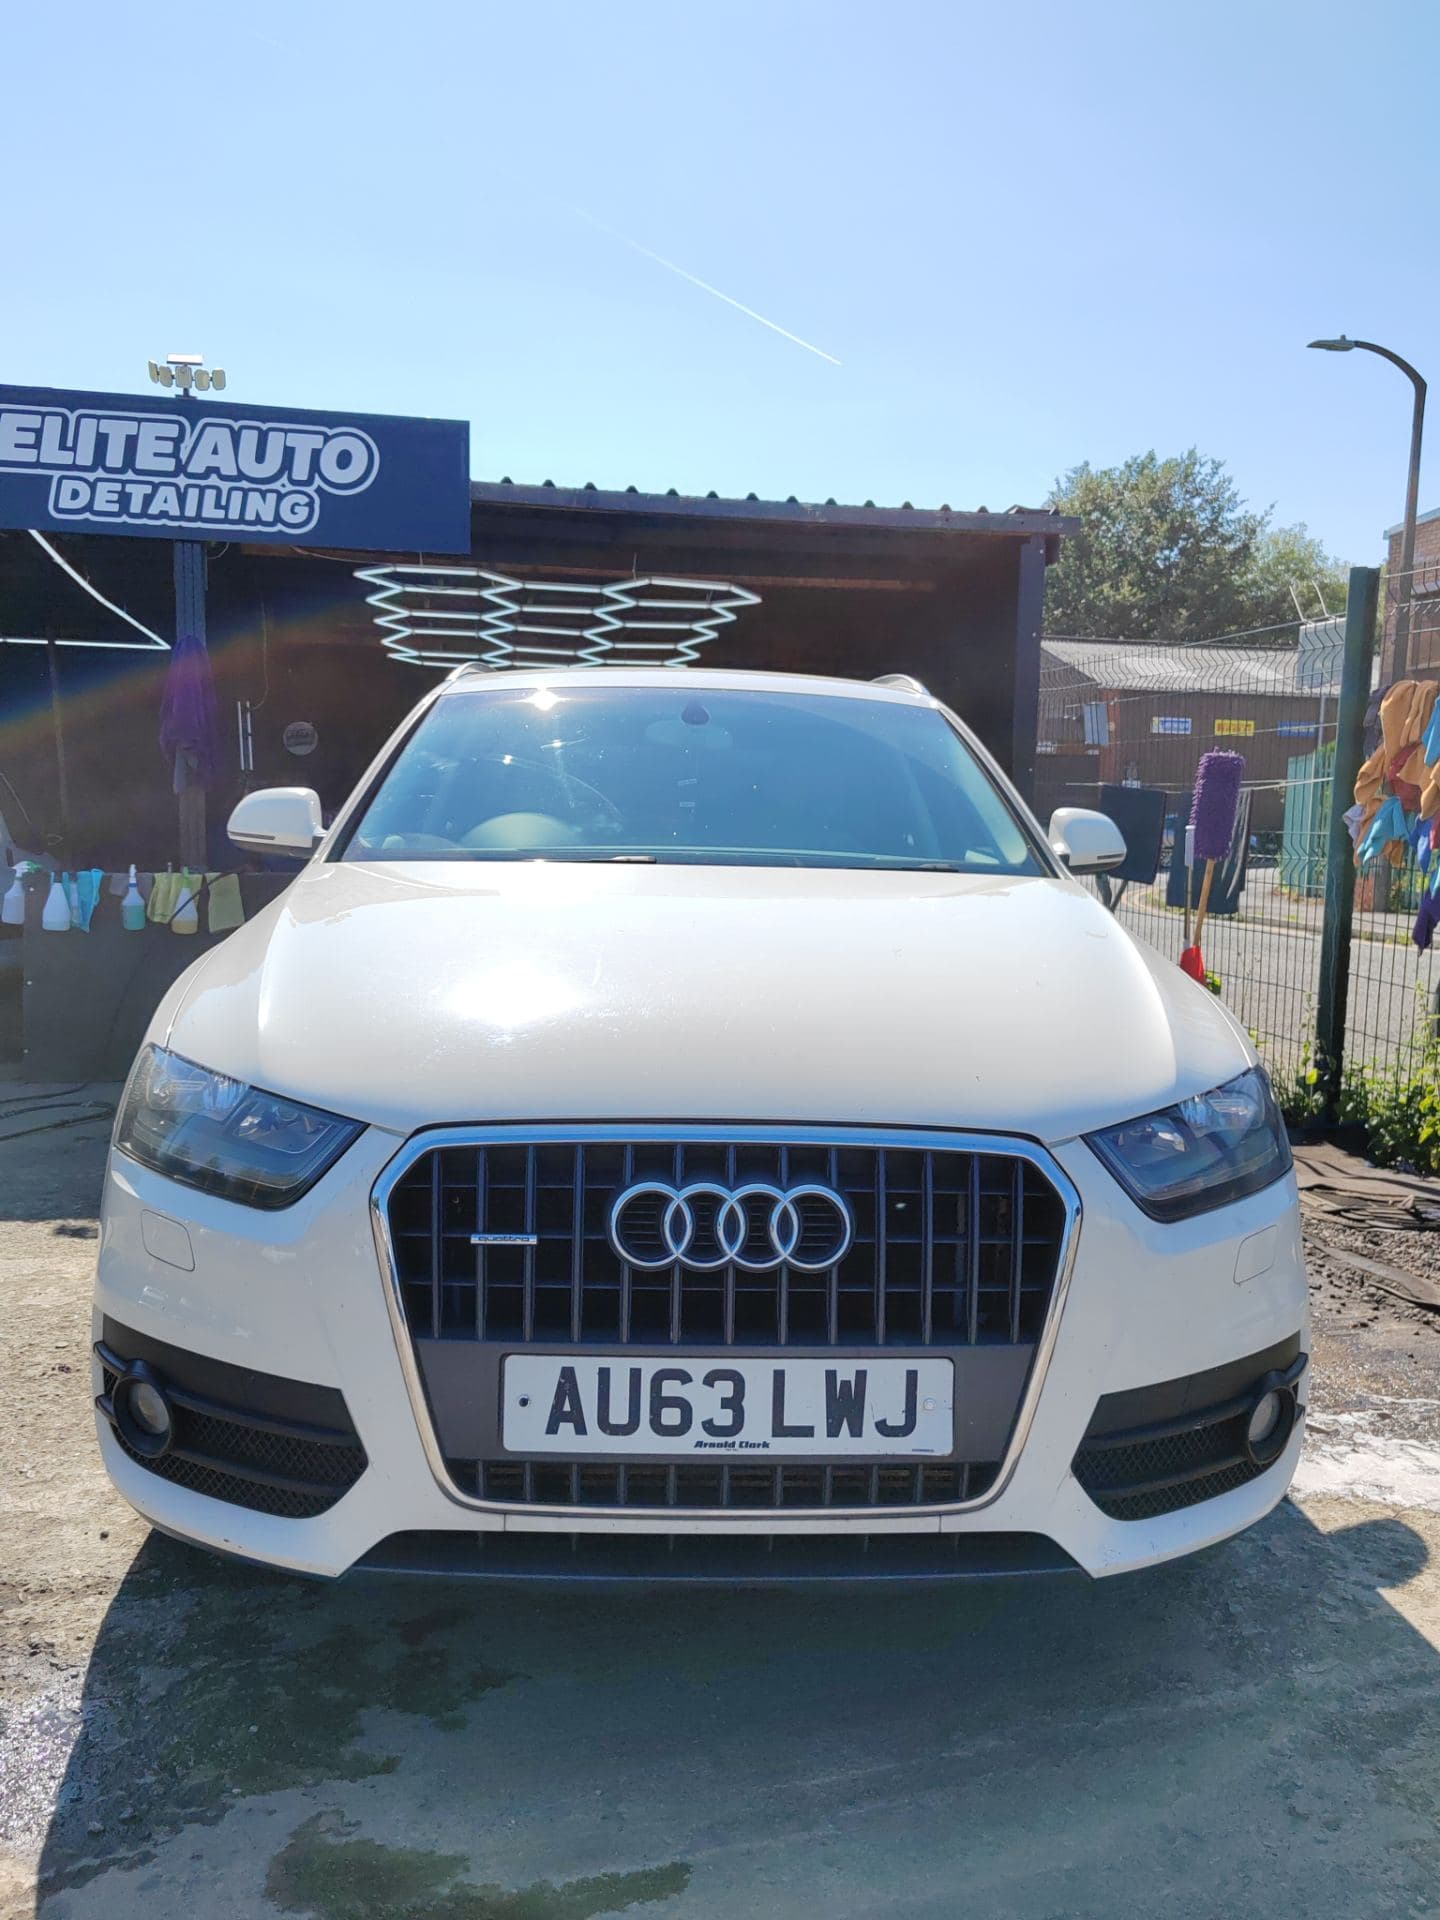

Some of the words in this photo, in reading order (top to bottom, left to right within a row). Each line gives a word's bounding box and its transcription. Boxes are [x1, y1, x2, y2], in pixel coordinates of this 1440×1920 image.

[0, 413, 180, 472] ELITE
[189, 426, 369, 484] AUTO
[58, 481, 311, 524] DETAILING
[545, 1366, 746, 1438] AU63
[771, 1368, 919, 1439] LWJ
[693, 1440, 736, 1449] Arnold
[738, 1440, 770, 1449] Clark
